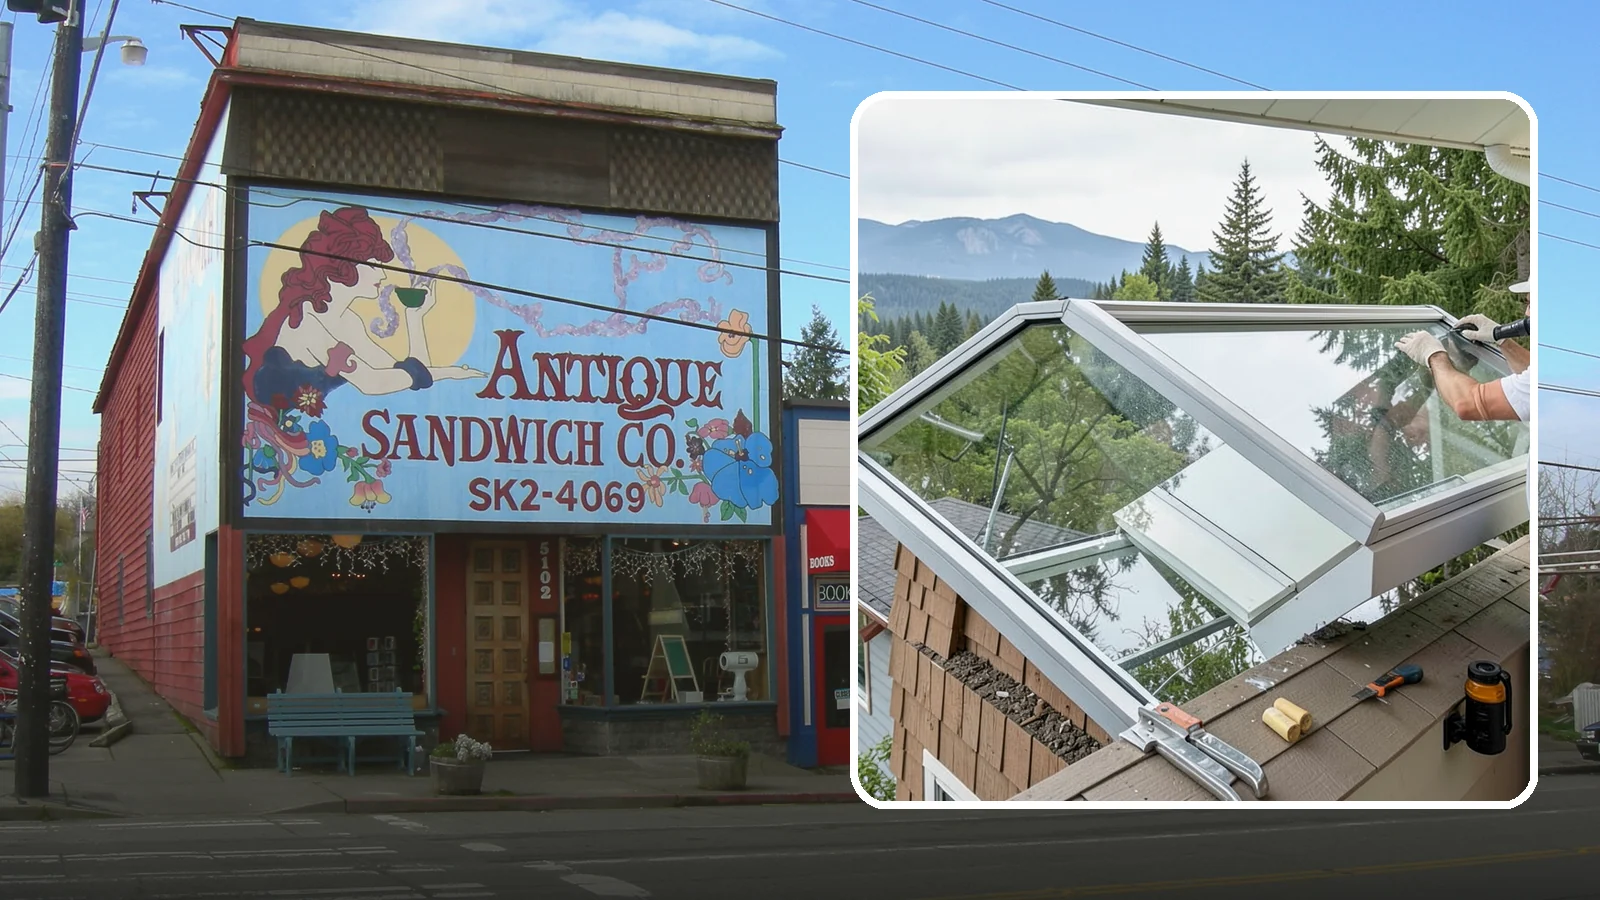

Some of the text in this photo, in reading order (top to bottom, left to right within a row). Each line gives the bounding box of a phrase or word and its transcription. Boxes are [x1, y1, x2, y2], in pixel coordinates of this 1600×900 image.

[476, 329, 723, 420] ANTIQUE
[361, 408, 685, 469] SANDWICH CO.
[468, 477, 646, 512] SK2-4069
[540, 543, 551, 600] 5102
[809, 555, 835, 569] BOOKS
